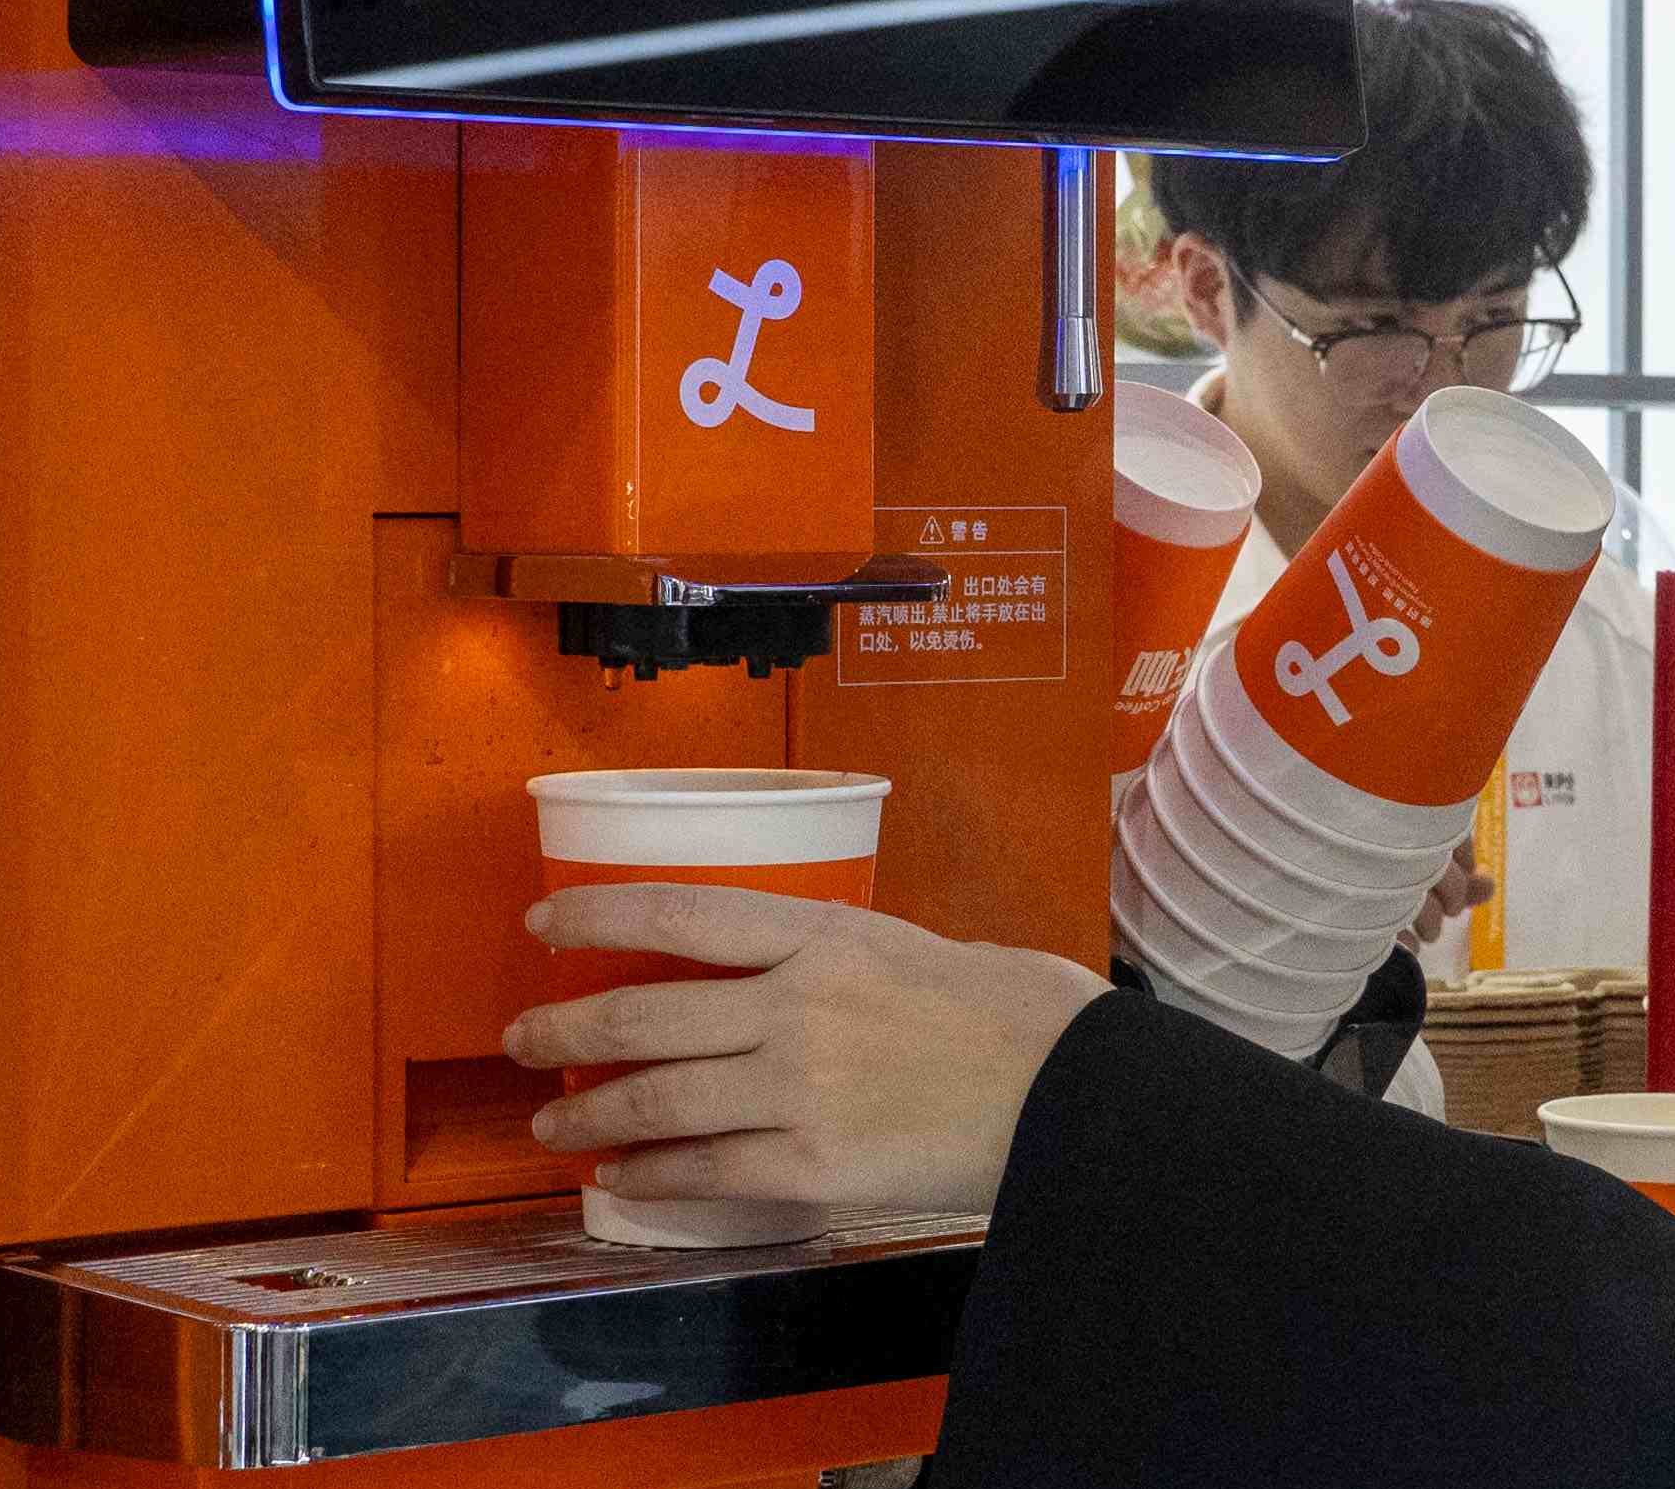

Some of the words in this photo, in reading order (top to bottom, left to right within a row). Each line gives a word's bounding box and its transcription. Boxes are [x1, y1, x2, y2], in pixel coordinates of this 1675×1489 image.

[950, 520, 989, 543] 警告
[963, 576, 1047, 597] 出口处会有
